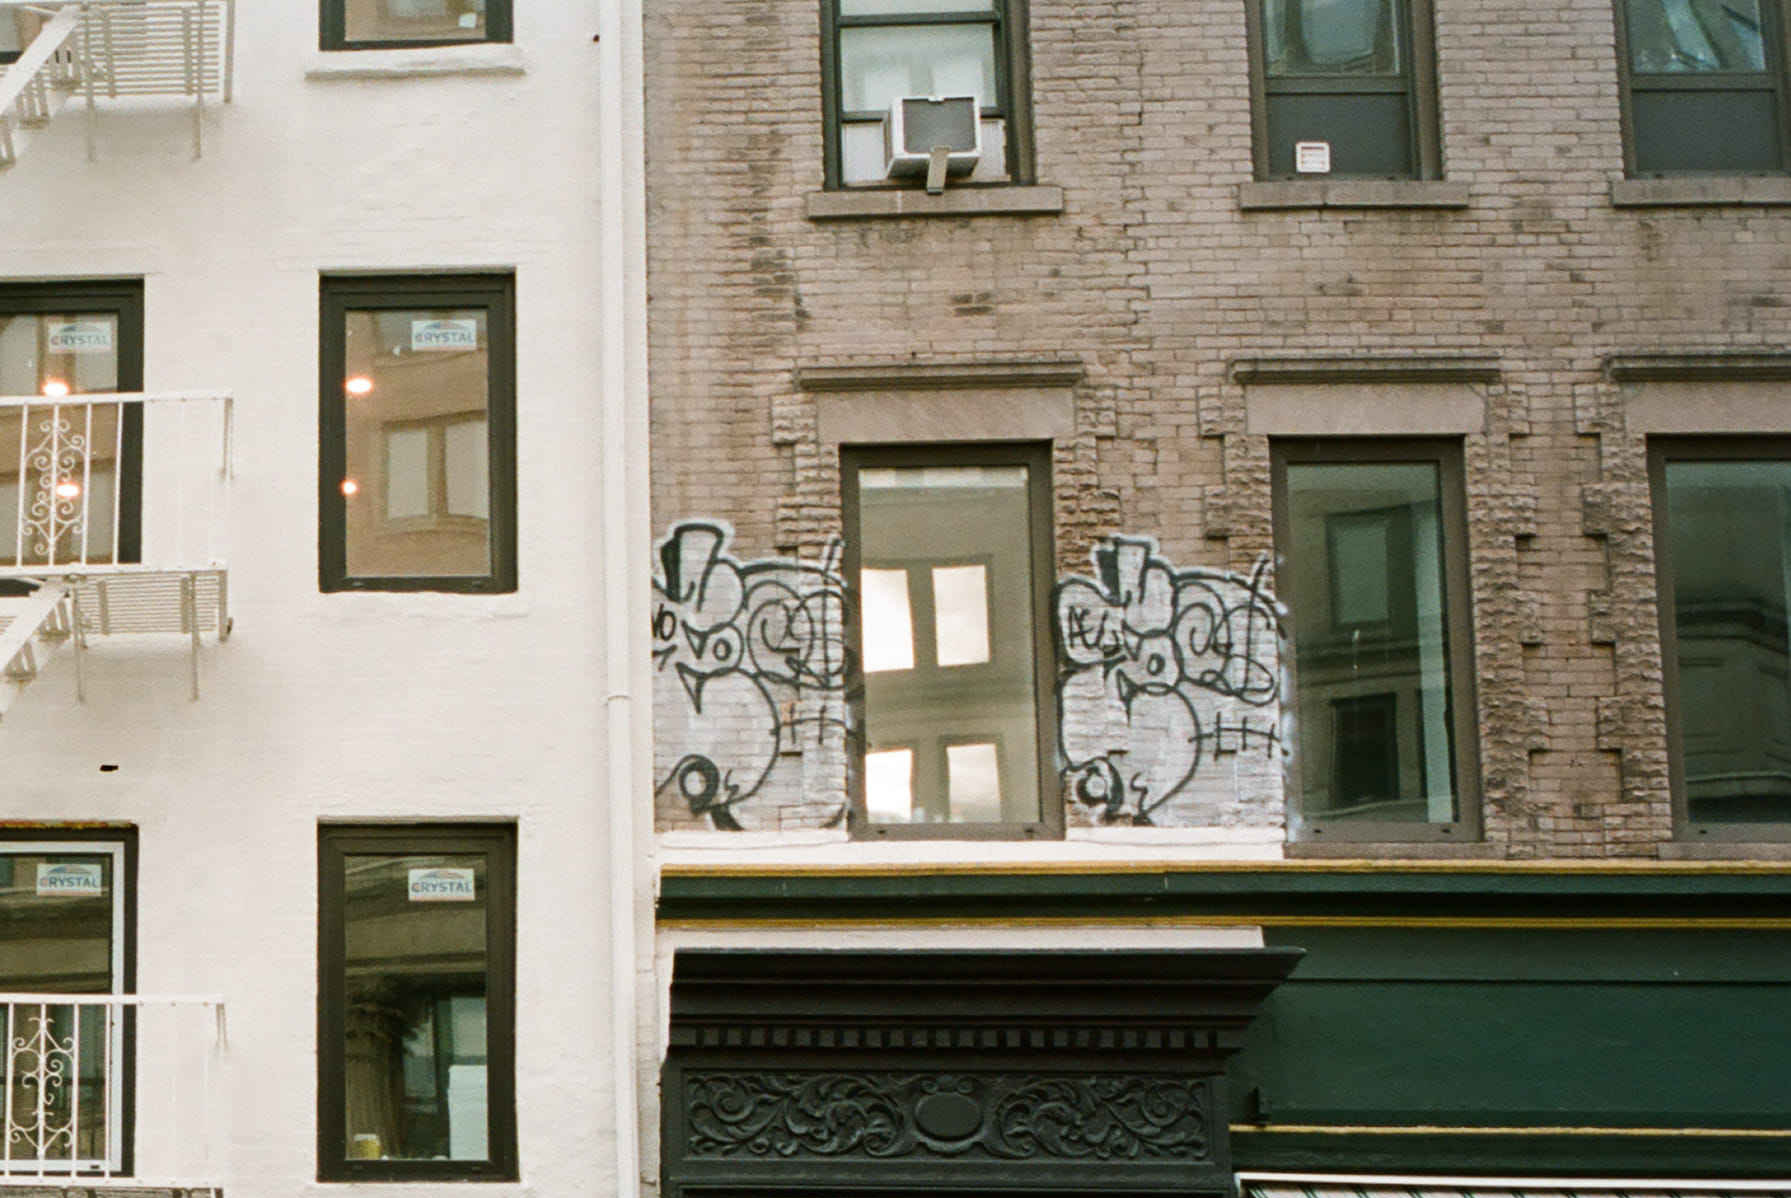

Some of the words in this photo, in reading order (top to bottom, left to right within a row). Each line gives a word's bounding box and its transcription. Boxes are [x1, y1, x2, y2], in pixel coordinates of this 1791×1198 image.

[49, 334, 110, 346] CRYSTAL
[415, 331, 474, 343] CRYSTAL
[39, 876, 99, 888] CRYSTAL
[411, 881, 472, 893] CRYSTAL
